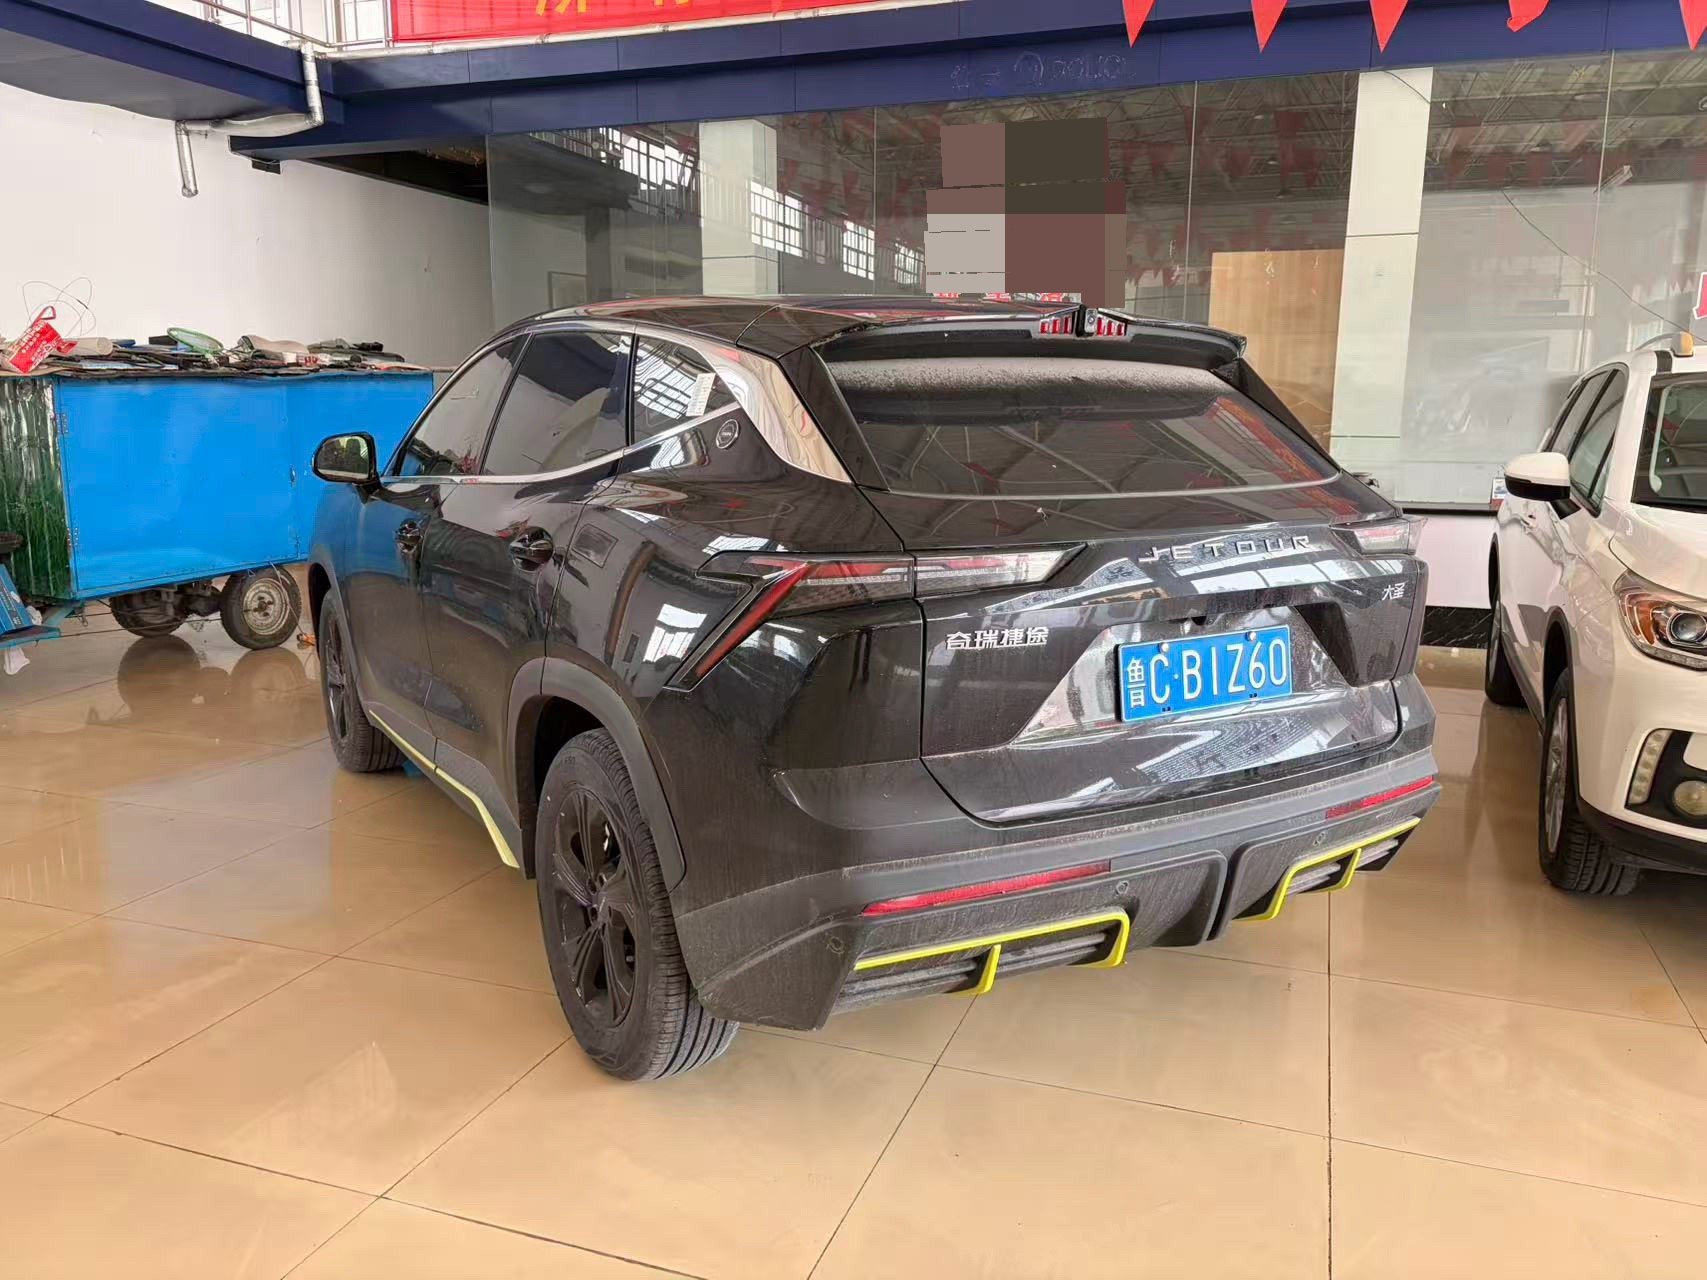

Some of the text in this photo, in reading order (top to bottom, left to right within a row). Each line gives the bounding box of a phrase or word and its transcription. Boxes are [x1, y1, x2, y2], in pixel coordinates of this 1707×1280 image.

[1137, 535, 1311, 563] JETOUR
[1381, 581, 1407, 601] 大圣
[945, 626, 1049, 651] 奇瑞捷途
